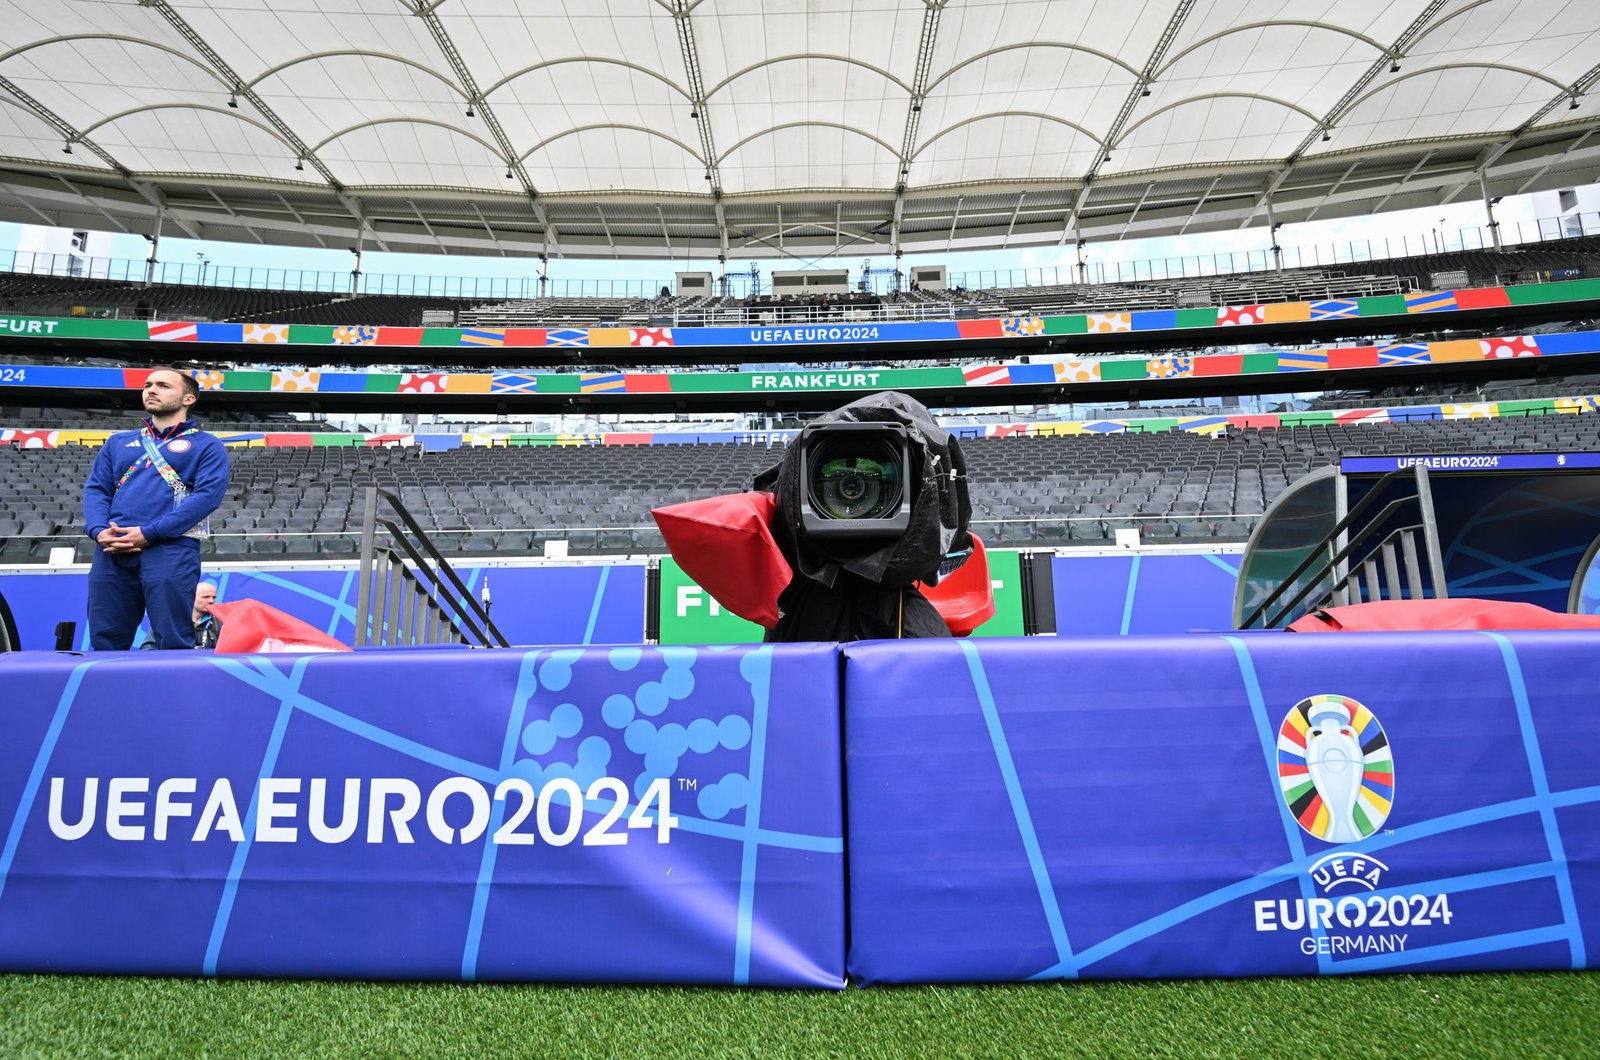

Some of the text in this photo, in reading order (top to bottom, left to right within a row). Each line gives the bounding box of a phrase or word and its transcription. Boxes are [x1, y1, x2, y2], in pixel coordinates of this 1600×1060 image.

[750, 327, 879, 343] UEFAEURO2024
[0, 368, 26, 382] 24
[751, 373, 881, 389] FRANKFURT
[48, 777, 678, 847] UEFAEURO2024
[1312, 858, 1383, 888] UEFA
[1254, 893, 1453, 932] EURO2024
[1300, 934, 1408, 956] GERMANY
